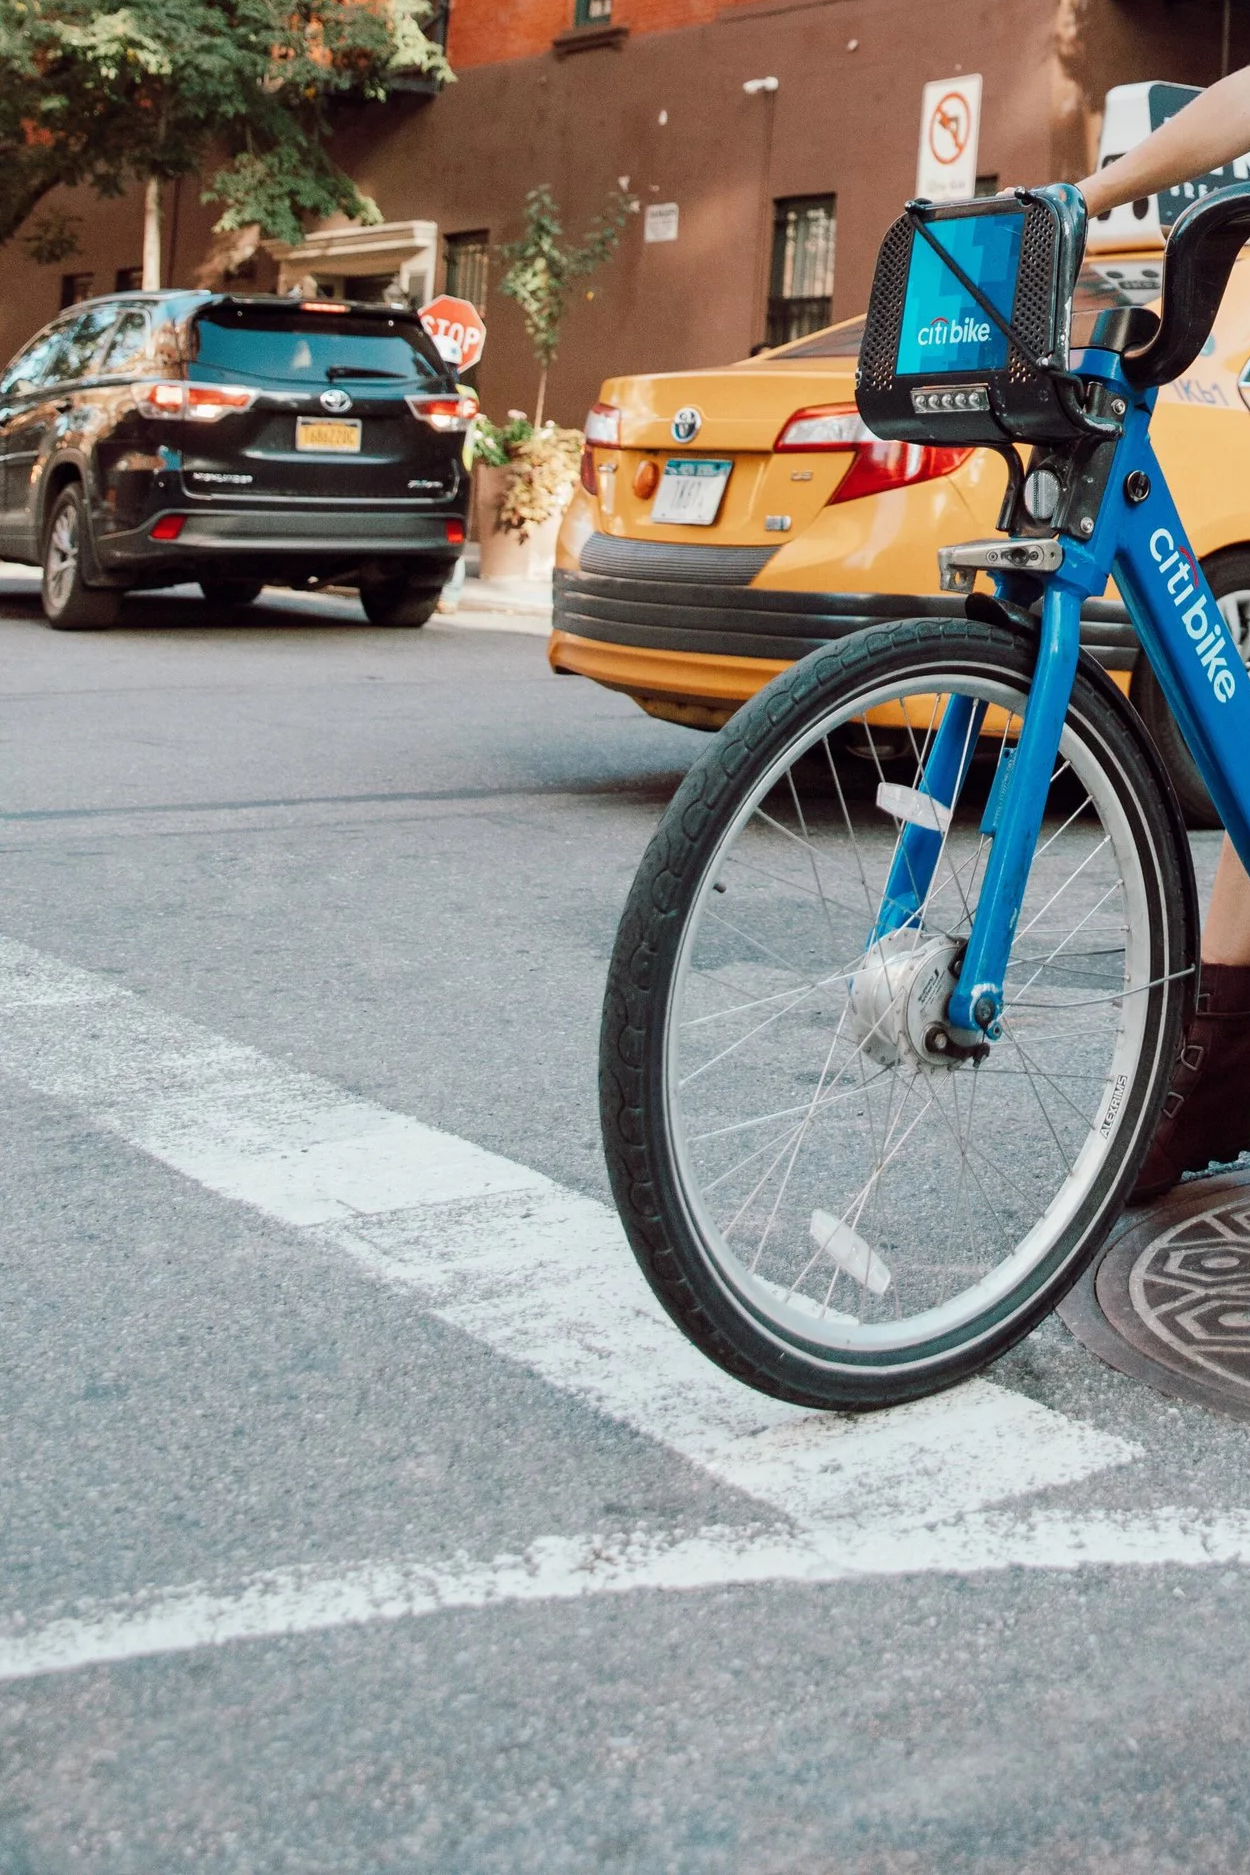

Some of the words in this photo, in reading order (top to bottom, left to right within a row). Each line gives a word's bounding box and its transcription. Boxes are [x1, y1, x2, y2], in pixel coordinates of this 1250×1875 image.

[420, 315, 480, 354] STOP
[918, 317, 949, 345] citi
[950, 317, 991, 344] bike
[1150, 528, 1199, 607] citi
[1181, 594, 1236, 704] bike
[1100, 1075, 1128, 1139] ALEXRIMS
